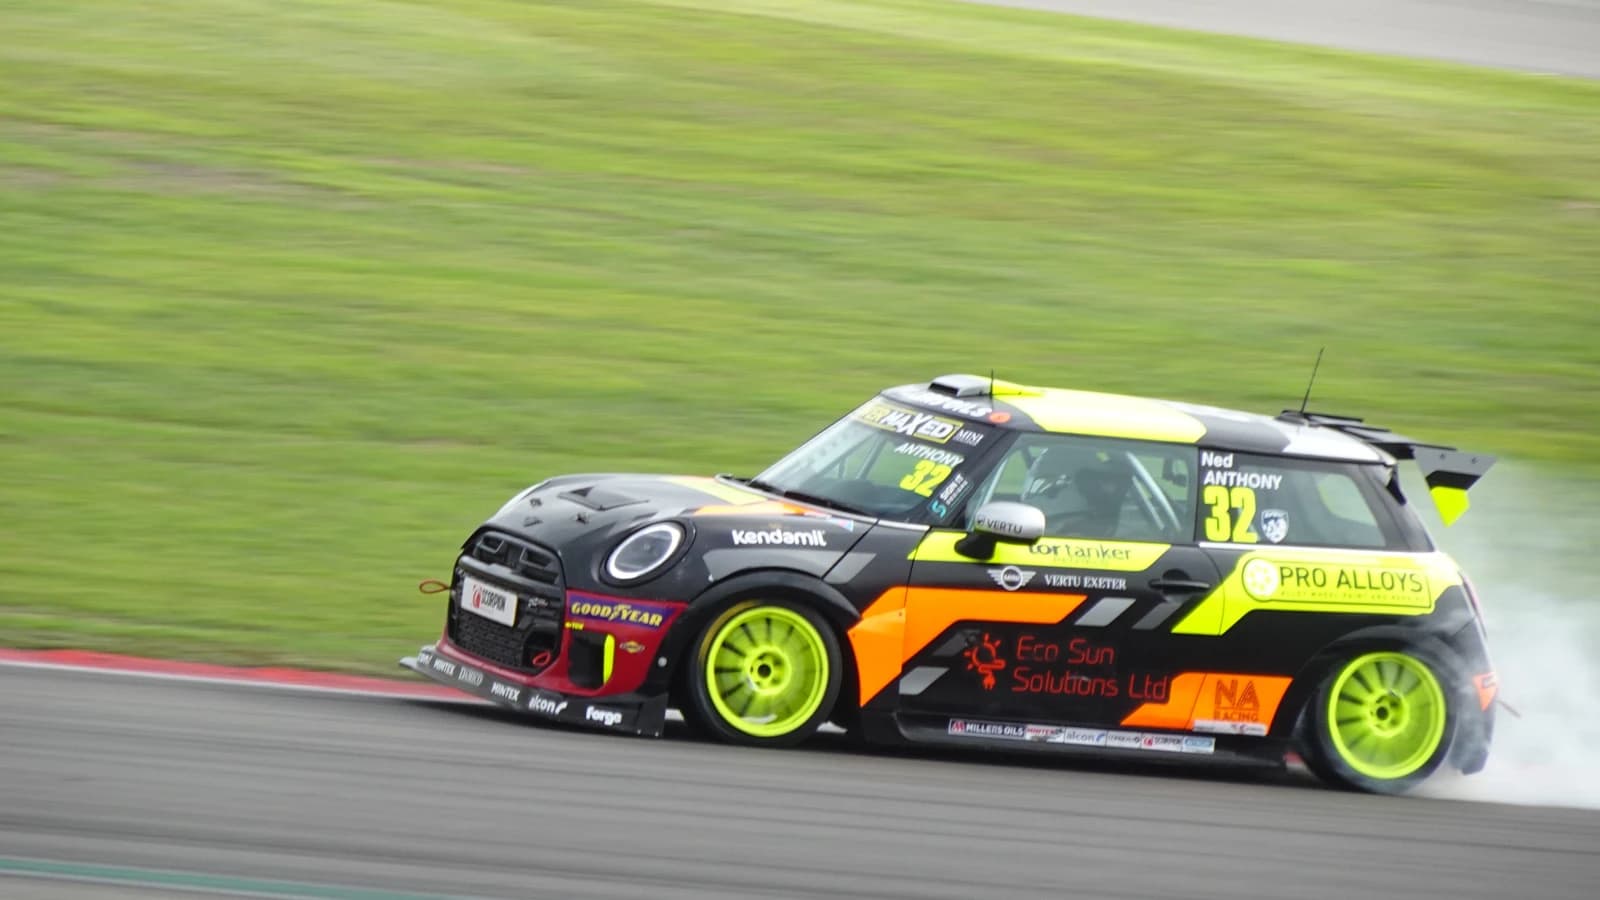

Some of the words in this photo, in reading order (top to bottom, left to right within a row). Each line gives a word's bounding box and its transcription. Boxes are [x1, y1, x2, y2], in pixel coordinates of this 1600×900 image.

[879, 410, 954, 438] MAXED
[895, 443, 964, 467] ANTHONY
[1201, 452, 1234, 468] Ned
[900, 460, 953, 498] 32
[1203, 470, 1282, 490] ANTHONY
[986, 519, 1023, 534] VERTU
[1203, 485, 1258, 544] 32
[1044, 574, 1081, 587] VERTU
[1083, 575, 1127, 590] EXETER
[1279, 566, 1327, 588] PRO
[1336, 569, 1423, 593] ALLOYS
[571, 602, 663, 627] GOODYEAR
[1016, 635, 1059, 661] Eco
[1068, 639, 1114, 664] Sun
[491, 682, 520, 702] MINTEX
[1011, 667, 1119, 697] Solutions
[1129, 674, 1168, 700] Ltd
[529, 694, 556, 714] alcon
[966, 723, 1003, 734] MILLERS
[1003, 726, 1024, 737] OILS
